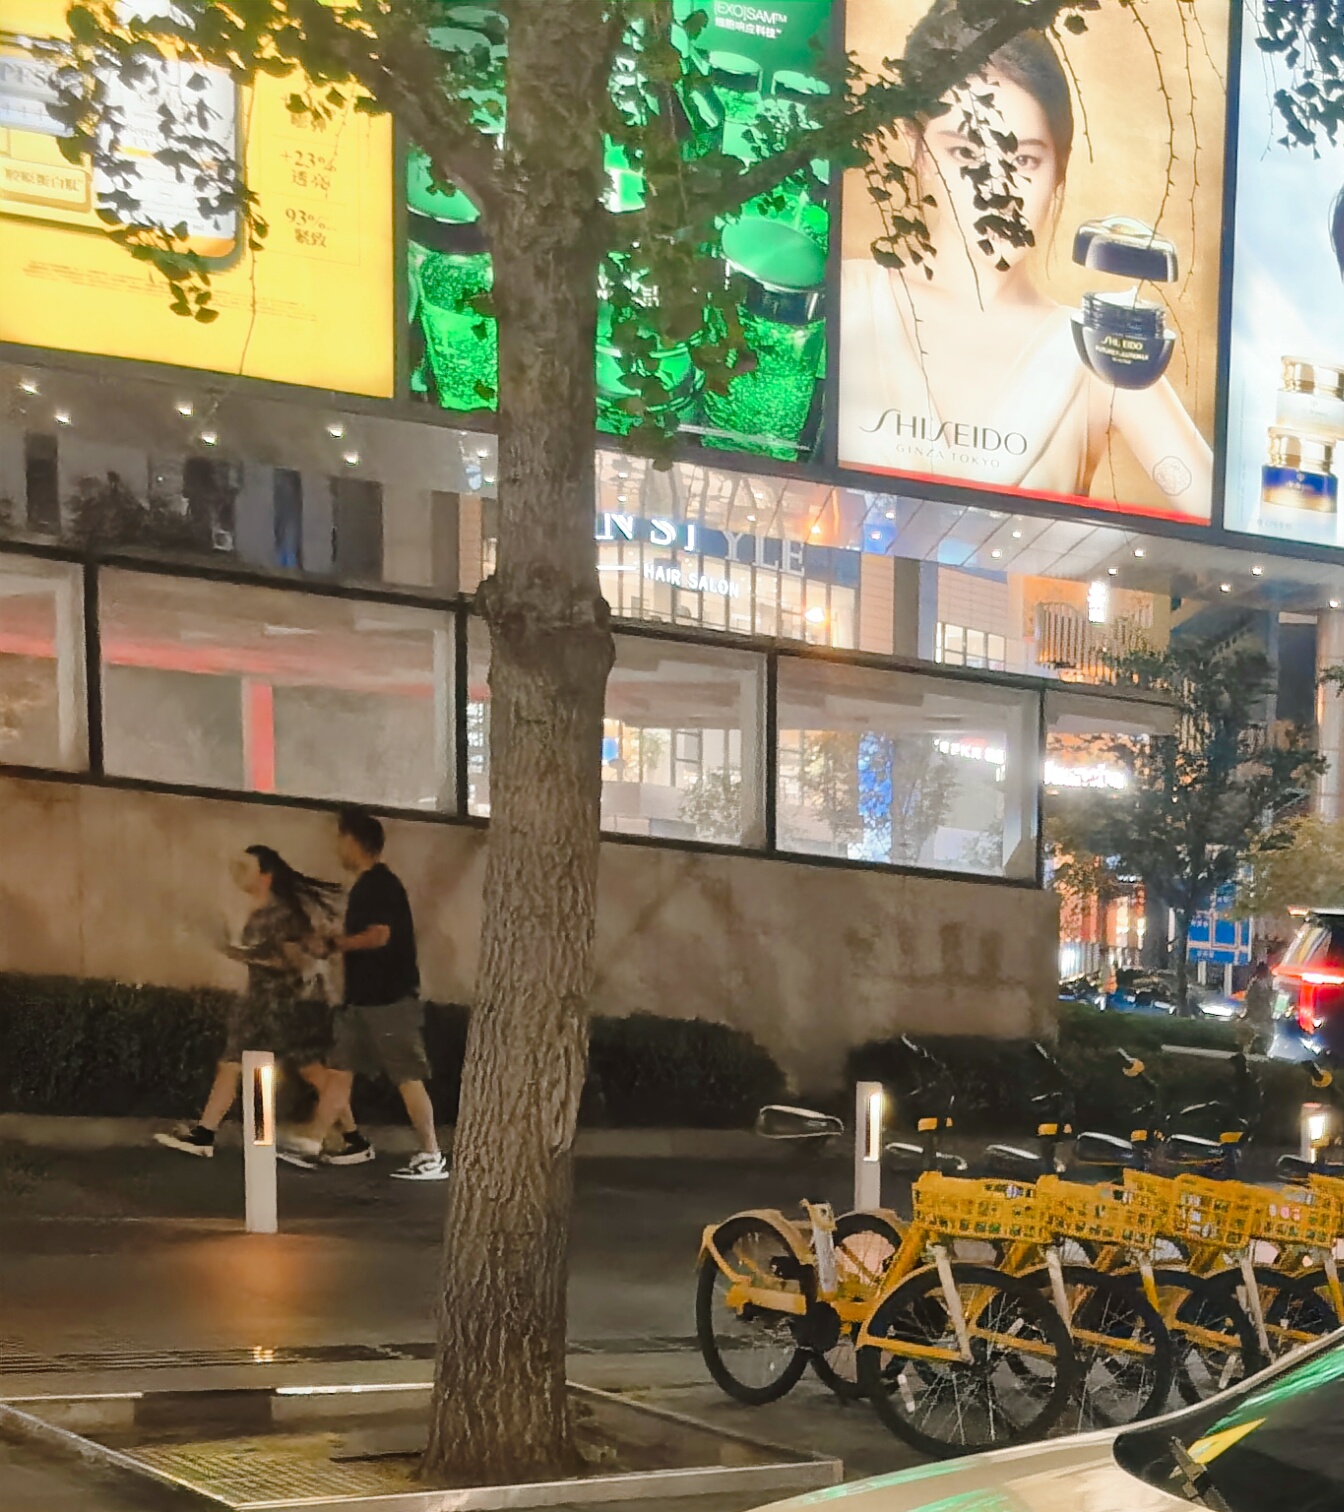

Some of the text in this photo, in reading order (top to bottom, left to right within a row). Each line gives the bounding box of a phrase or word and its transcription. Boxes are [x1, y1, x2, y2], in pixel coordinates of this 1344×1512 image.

[858, 408, 1028, 456] SHISEIDO
[896, 444, 1000, 468] GINZA TOKYO
[643, 563, 740, 598] HAIR SALON
